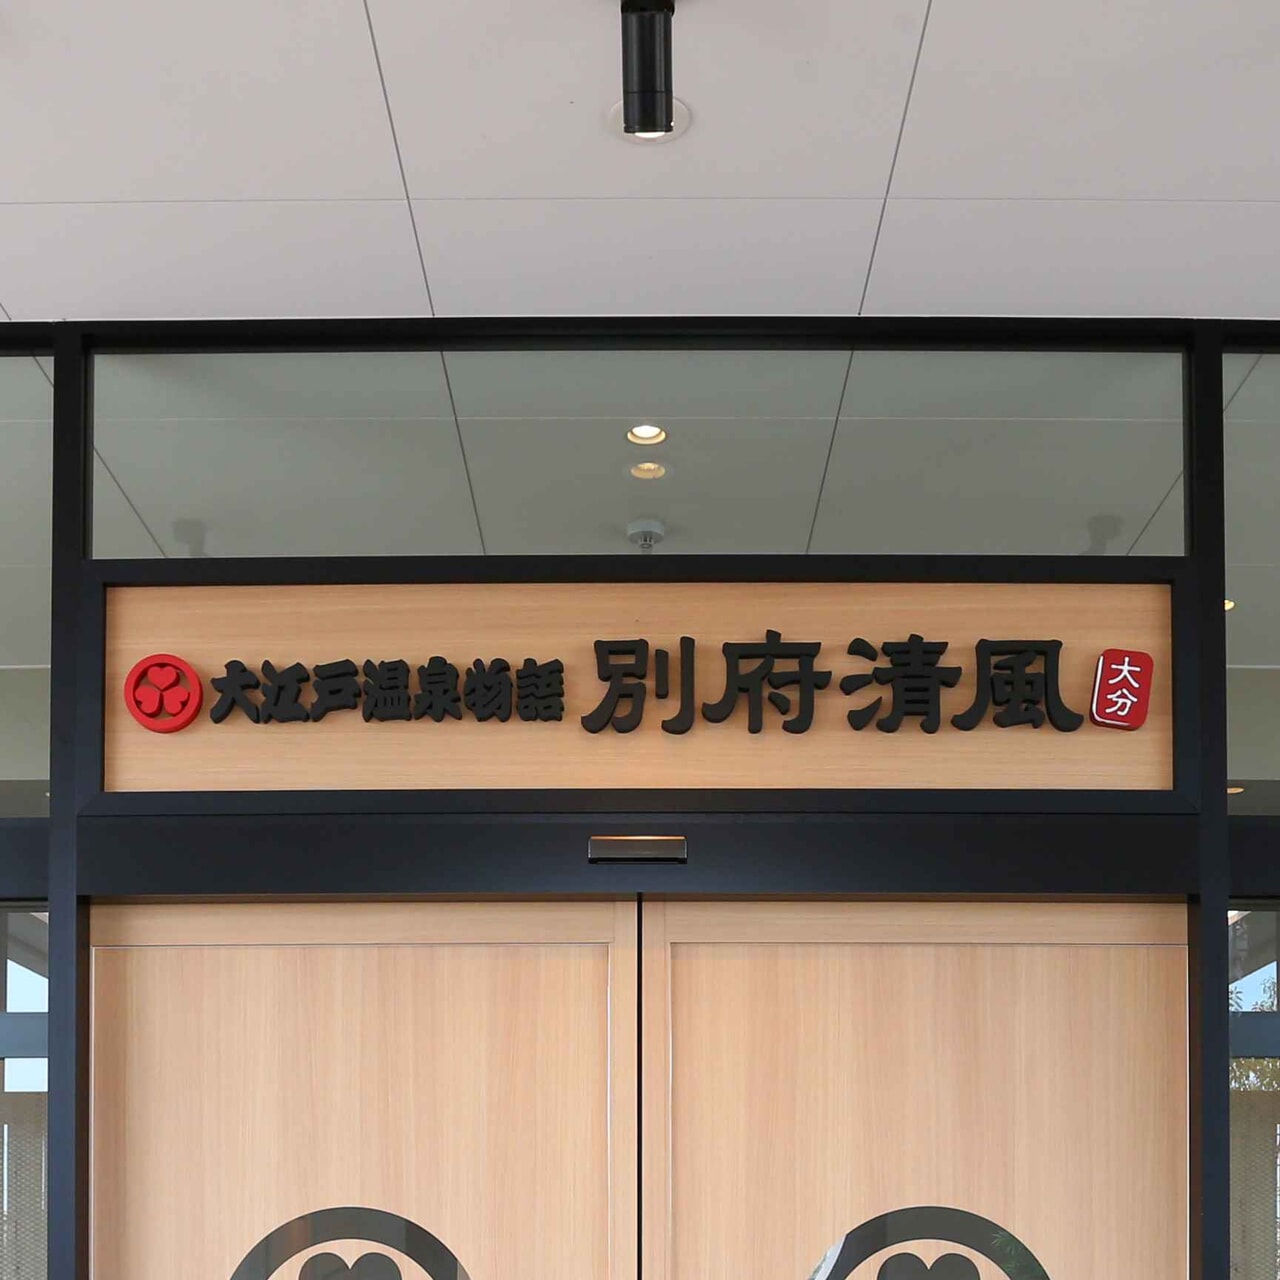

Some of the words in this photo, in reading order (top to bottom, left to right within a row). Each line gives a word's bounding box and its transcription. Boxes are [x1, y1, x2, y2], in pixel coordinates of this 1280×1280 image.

[209, 655, 565, 724] 大江戸温泉物語
[580, 629, 1085, 735] 別府清風
[1104, 656, 1142, 716] 大分
